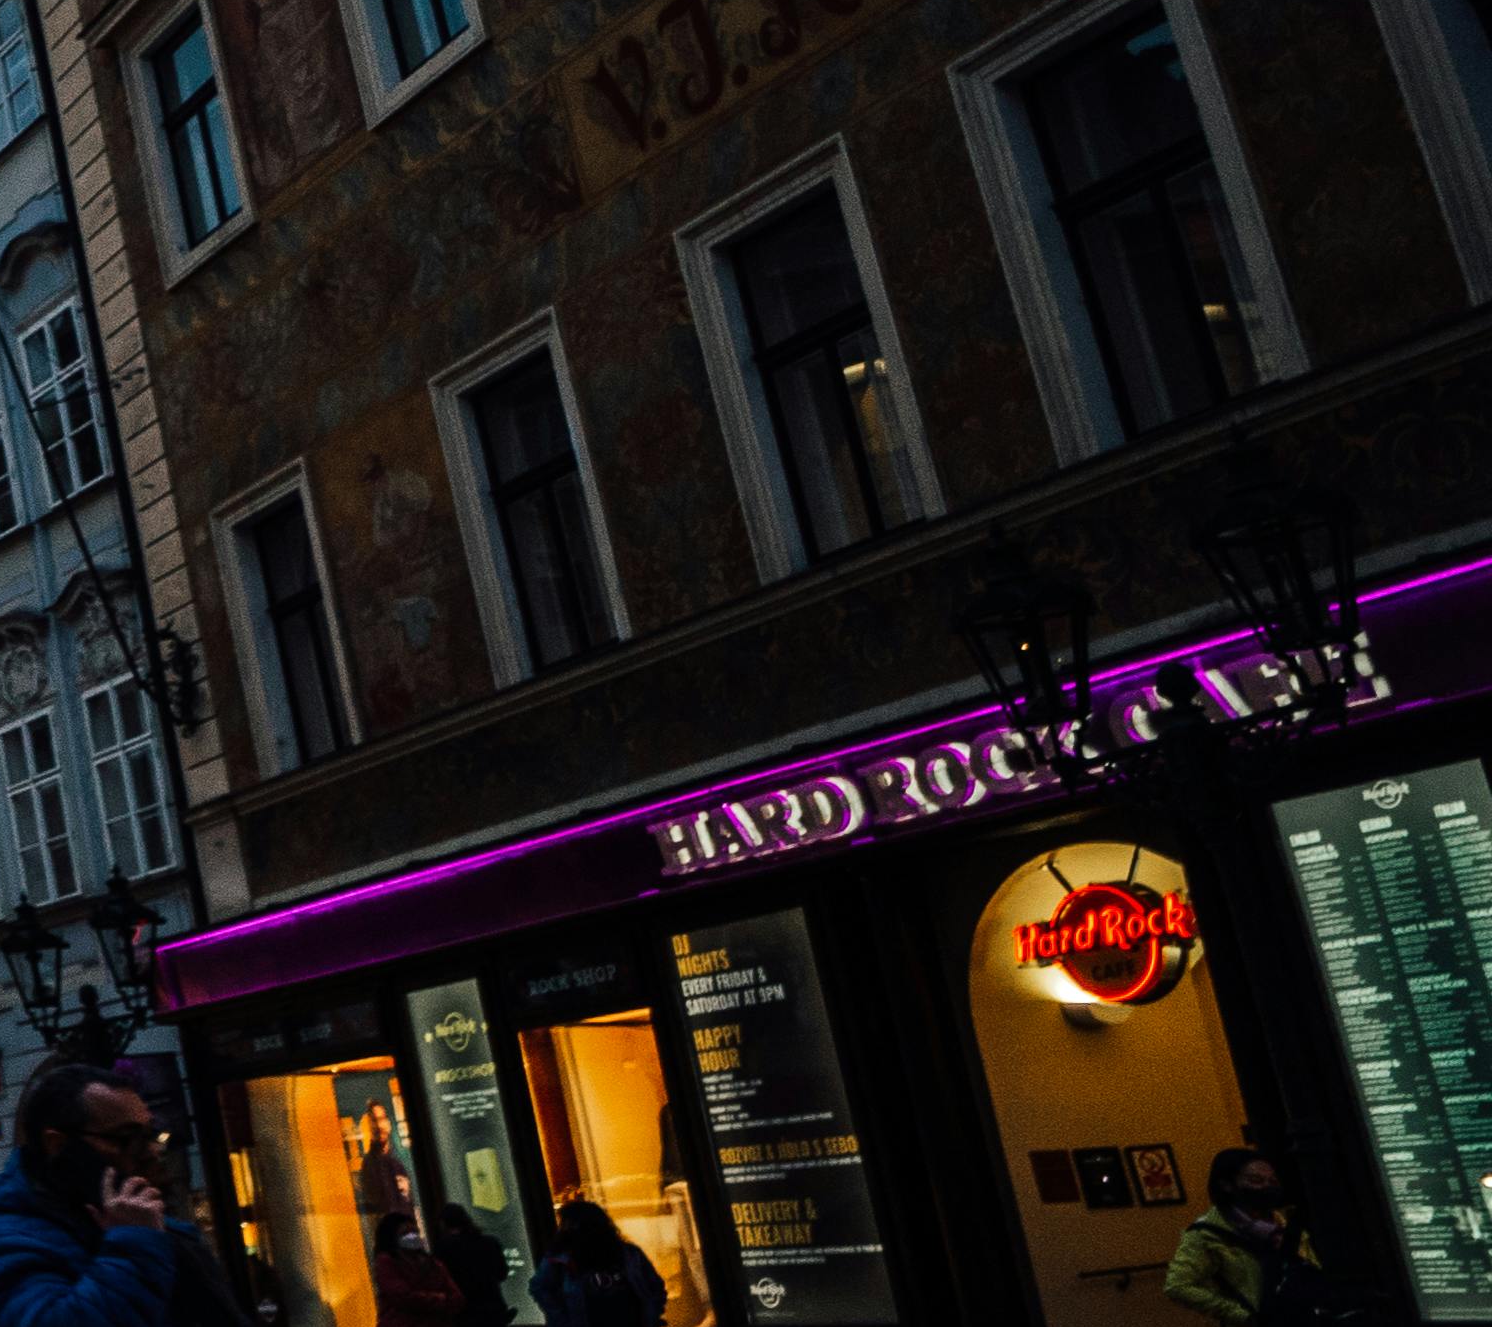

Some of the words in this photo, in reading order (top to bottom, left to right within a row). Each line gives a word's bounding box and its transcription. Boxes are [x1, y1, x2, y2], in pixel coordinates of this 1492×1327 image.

[645, 774, 866, 877] HARD
[856, 709, 1104, 824] ROCK
[1012, 908, 1097, 963] Hard
[1098, 892, 1195, 951] Rock
[676, 947, 732, 978] NIGHTS
[681, 976, 715, 998] EVERY
[716, 968, 755, 992] FRIDAY
[685, 991, 741, 1017] SATURDAY
[744, 989, 758, 1006] AT
[692, 1024, 742, 1051] HAPPY
[697, 1047, 741, 1074] HOUR
[731, 1200, 800, 1225] DELIVERY
[735, 1222, 813, 1249] TAKEAWAY
